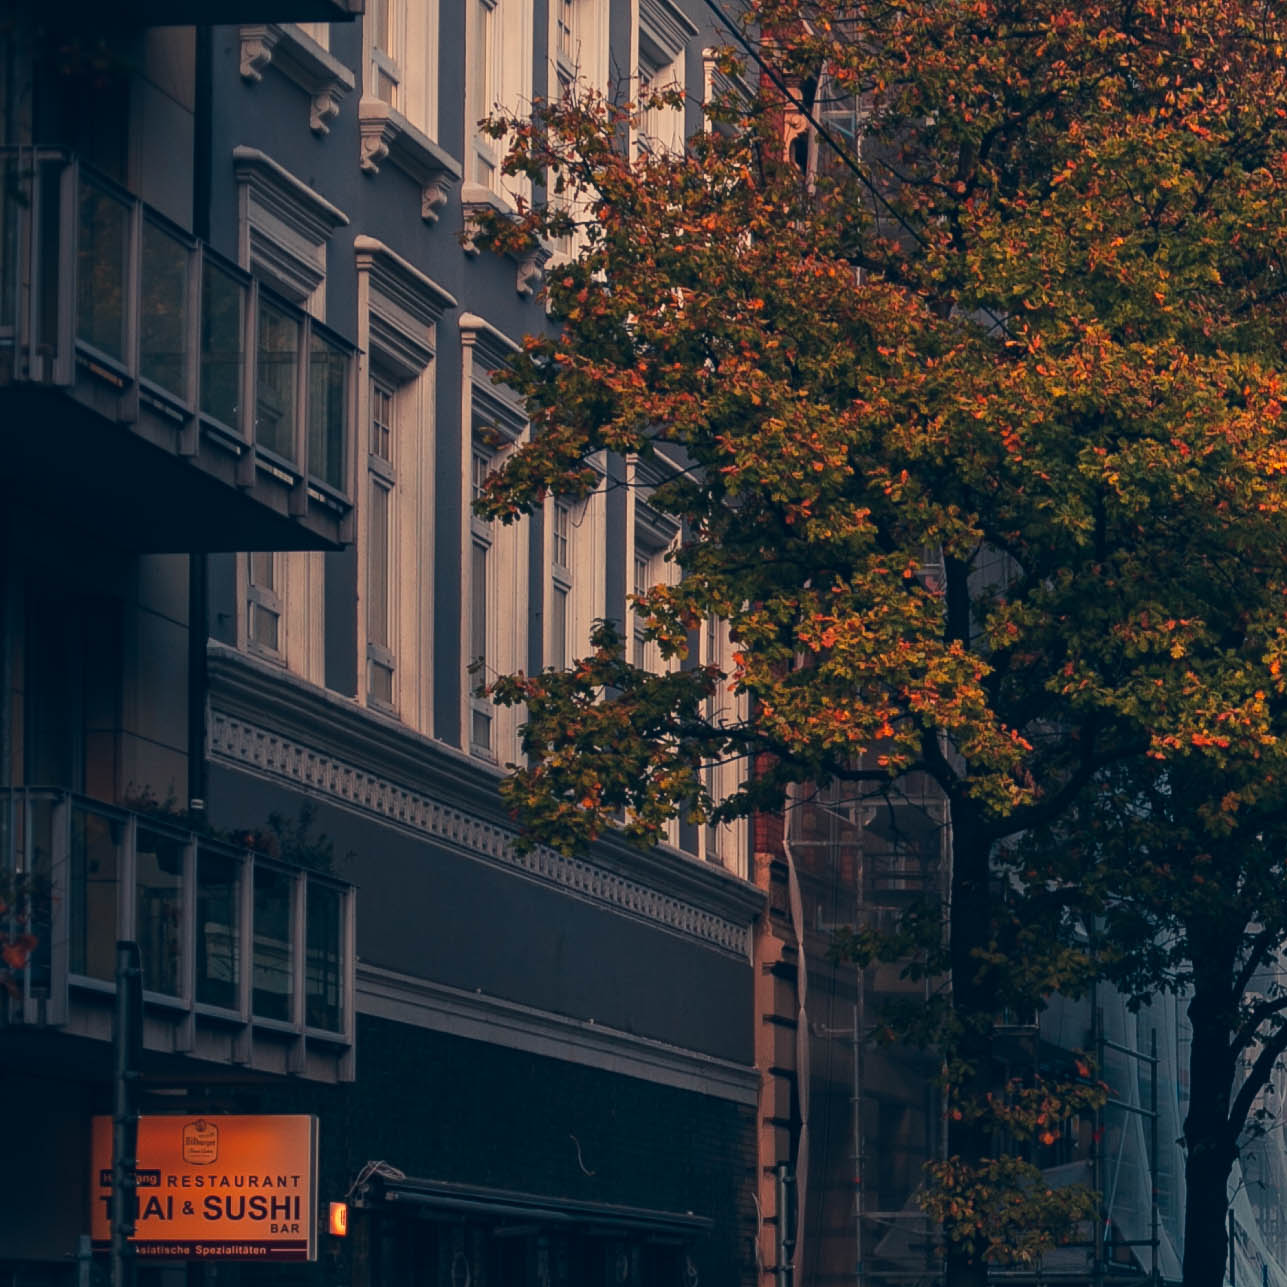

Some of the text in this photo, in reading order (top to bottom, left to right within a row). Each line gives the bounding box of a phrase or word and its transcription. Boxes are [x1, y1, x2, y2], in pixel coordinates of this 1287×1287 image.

[166, 1175, 301, 1188] RESTAURANT
[181, 1200, 195, 1216] &
[202, 1195, 301, 1221] SUSHI
[270, 1223, 300, 1234] BAR
[194, 1244, 267, 1257] Spezialitäten
